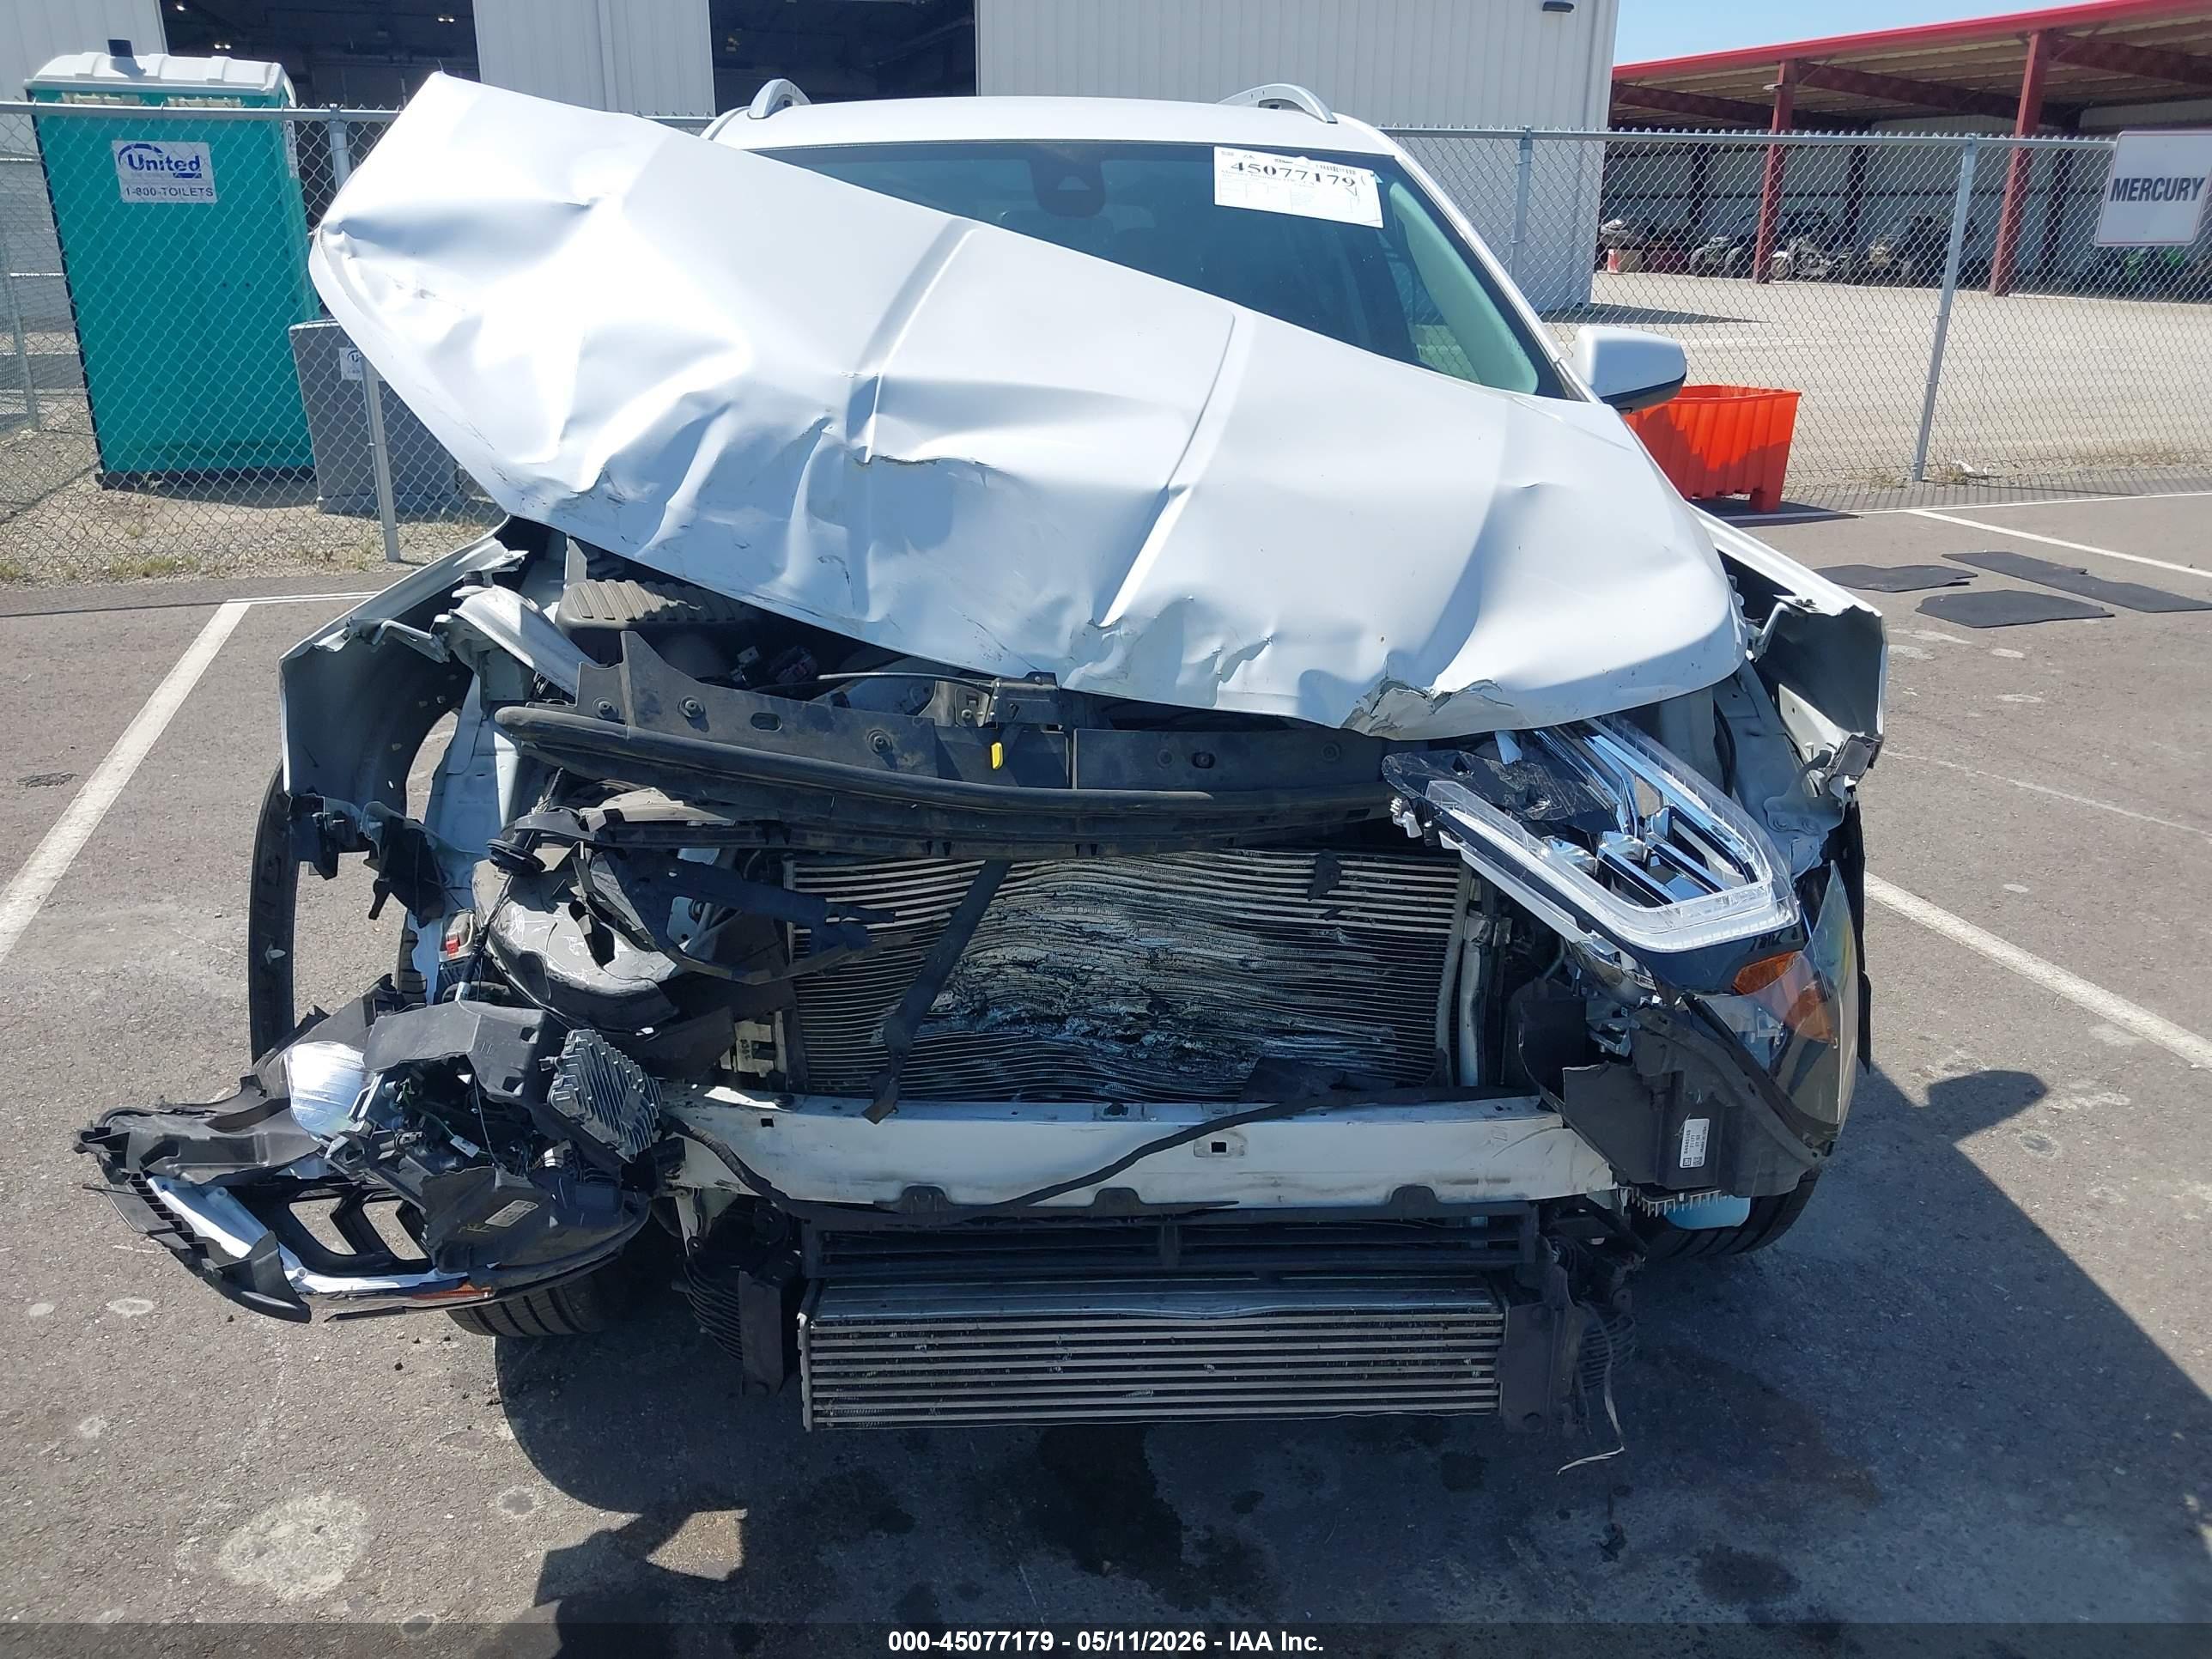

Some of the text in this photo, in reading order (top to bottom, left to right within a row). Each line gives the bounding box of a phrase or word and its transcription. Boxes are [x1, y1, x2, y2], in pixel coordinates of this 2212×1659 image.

[127, 154, 201, 171] United
[1231, 161, 1356, 187] 45077179
[125, 187, 214, 197] 1-800-TOILETS
[2109, 177, 2206, 202] MERCURY
